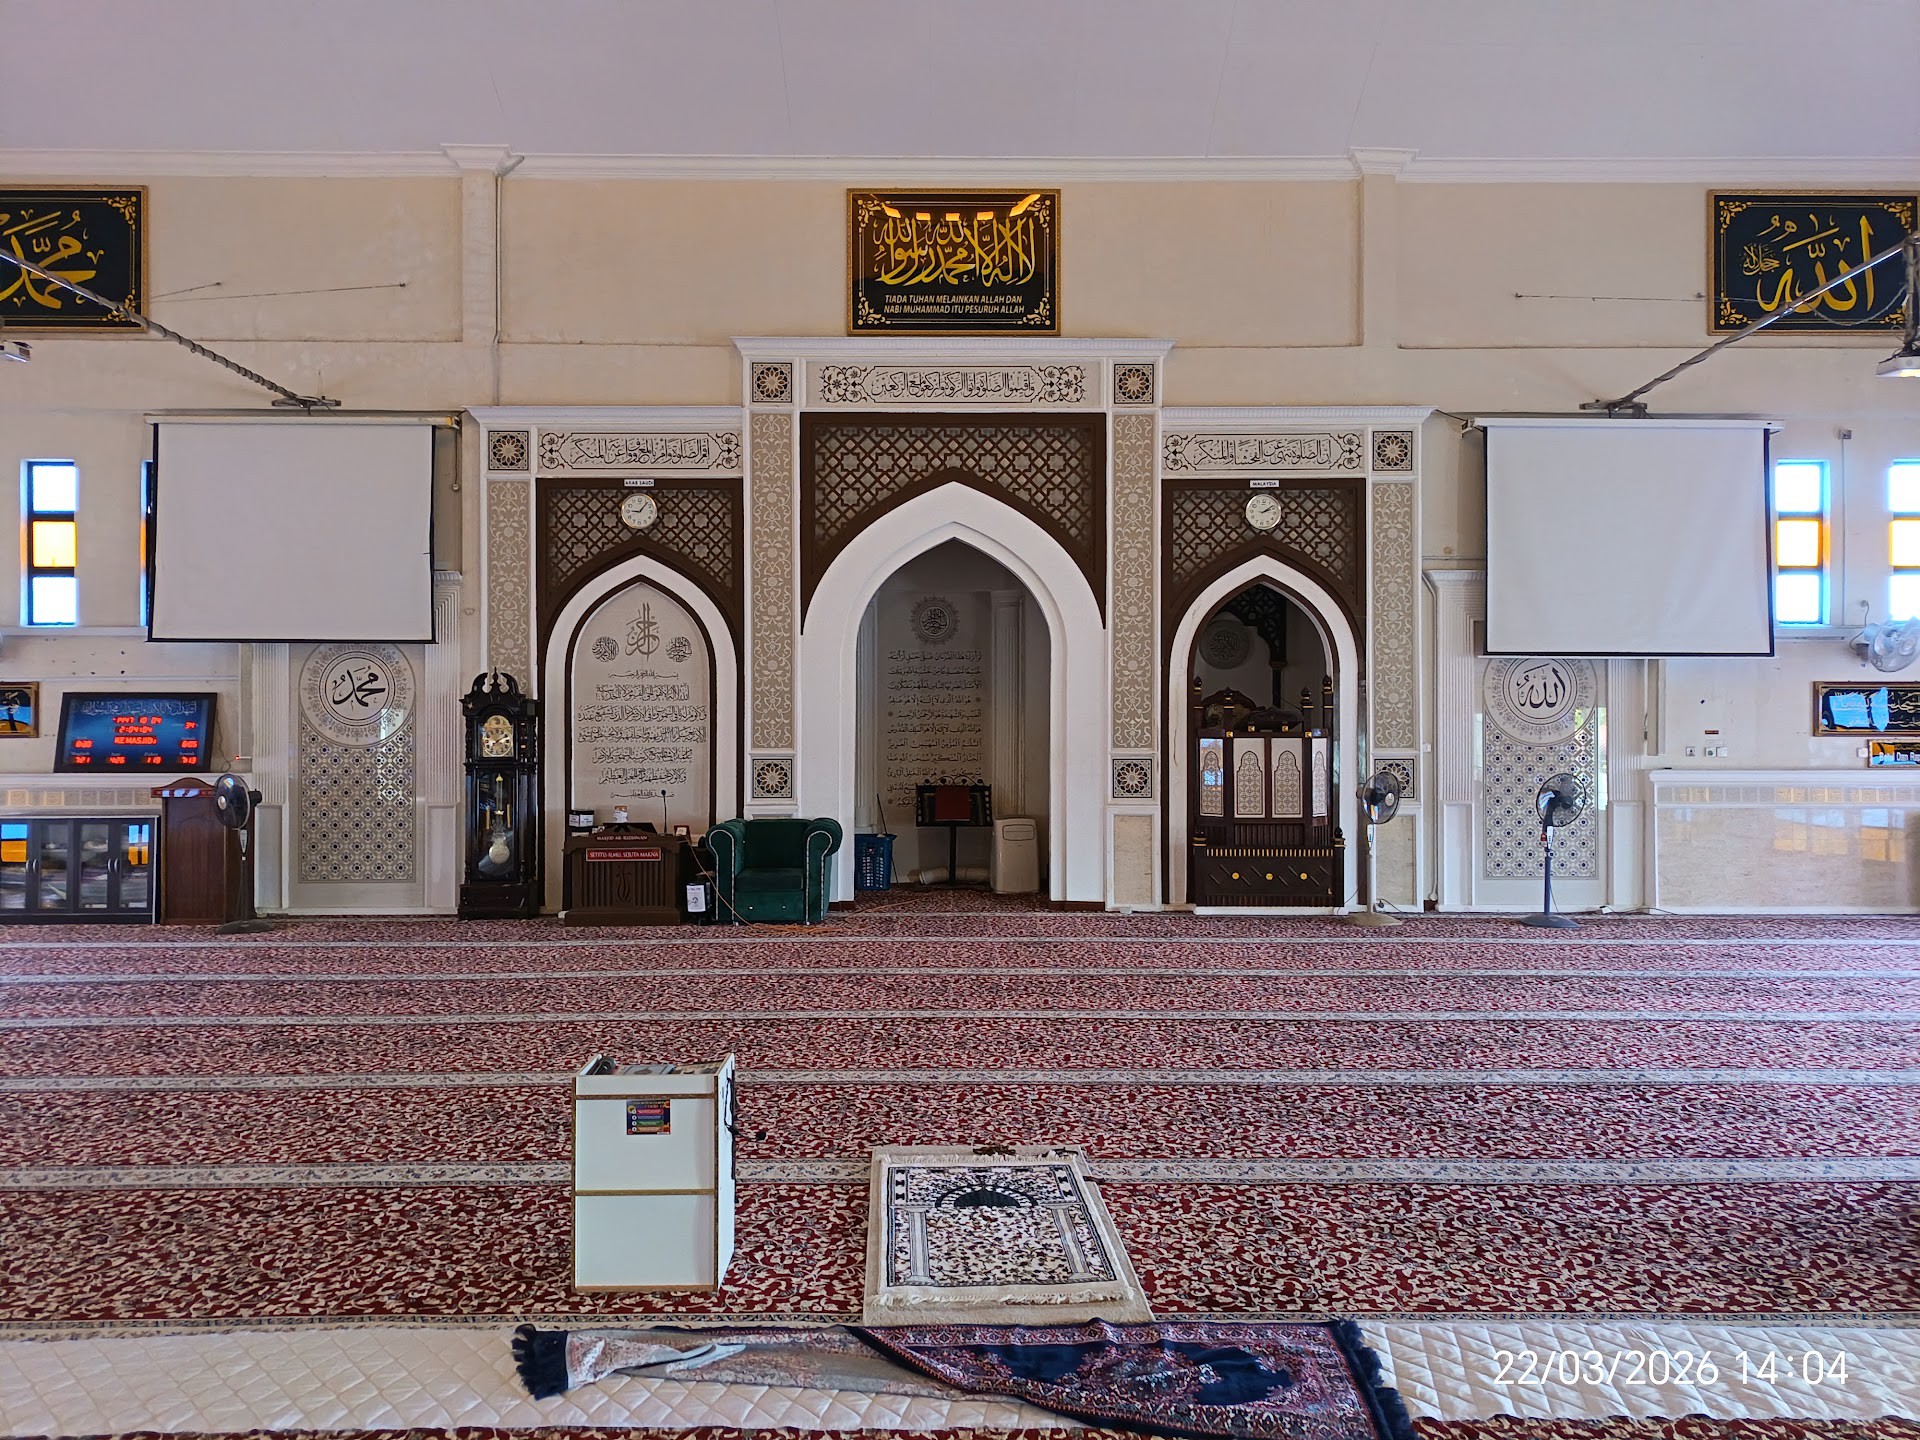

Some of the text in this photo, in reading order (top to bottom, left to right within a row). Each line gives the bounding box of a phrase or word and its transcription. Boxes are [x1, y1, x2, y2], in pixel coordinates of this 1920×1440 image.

[884, 305, 1025, 313] NABI MUHAMMAD ITU PESURUH ALLAH
[885, 295, 1022, 303] TIADA TUHAN MELAINKAN ALLAH DAN
[332, 667, 386, 708] محمد
[1516, 664, 1566, 708] الله
